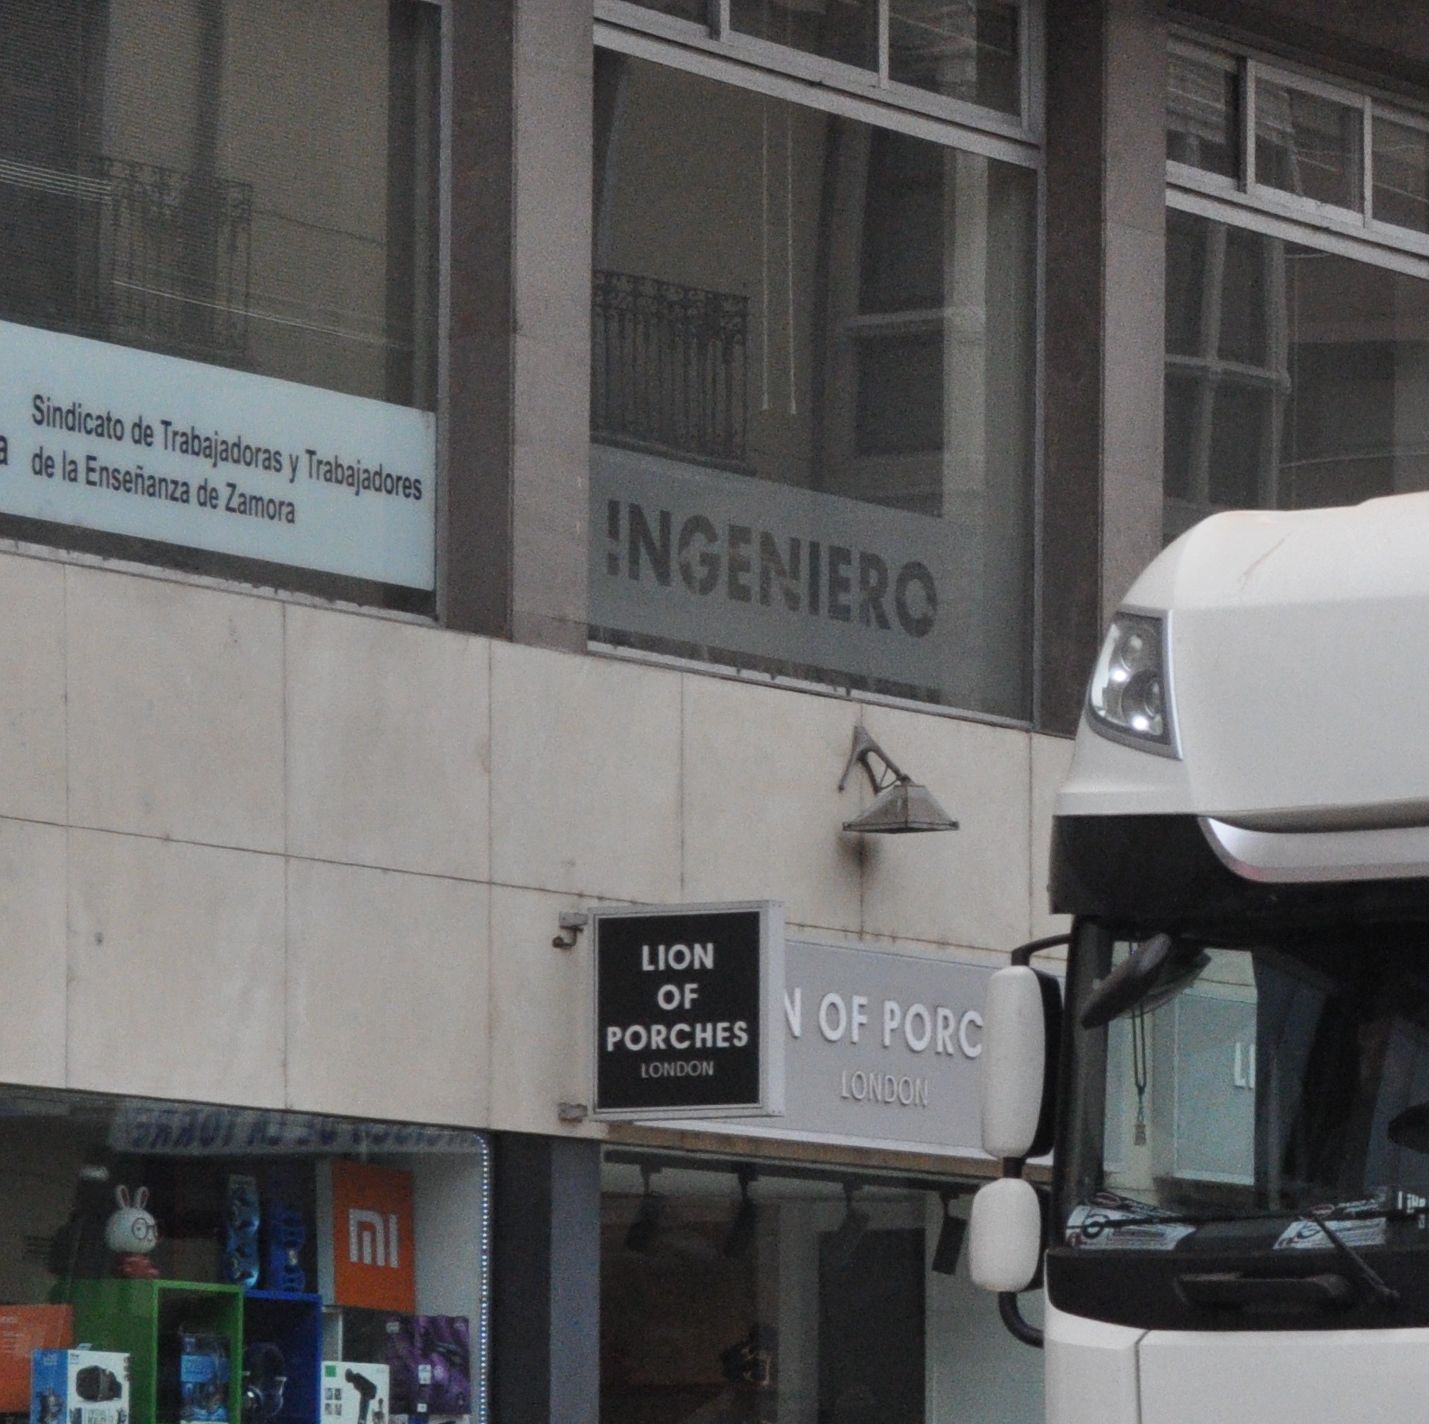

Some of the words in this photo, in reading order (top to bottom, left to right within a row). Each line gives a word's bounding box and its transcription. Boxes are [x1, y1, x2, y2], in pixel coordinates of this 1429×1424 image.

[31, 393, 125, 443] Sindicato
[131, 419, 154, 447] de
[161, 419, 283, 473] Trabajadoras
[287, 453, 299, 484] y
[305, 448, 423, 501] Trabajadores
[31, 446, 55, 479] de
[62, 449, 78, 483] la
[85, 455, 190, 505] Enseñanza
[196, 478, 219, 510] de
[225, 482, 296, 524] Zamora
[606, 500, 938, 639] INGENIERO
[641, 942, 714, 972] LION
[657, 983, 699, 1010] OF
[606, 1020, 749, 1052] PORCHES
[818, 992, 869, 1045] OF
[640, 1060, 715, 1078] LONDON
[840, 1070, 929, 1108] LONDON
